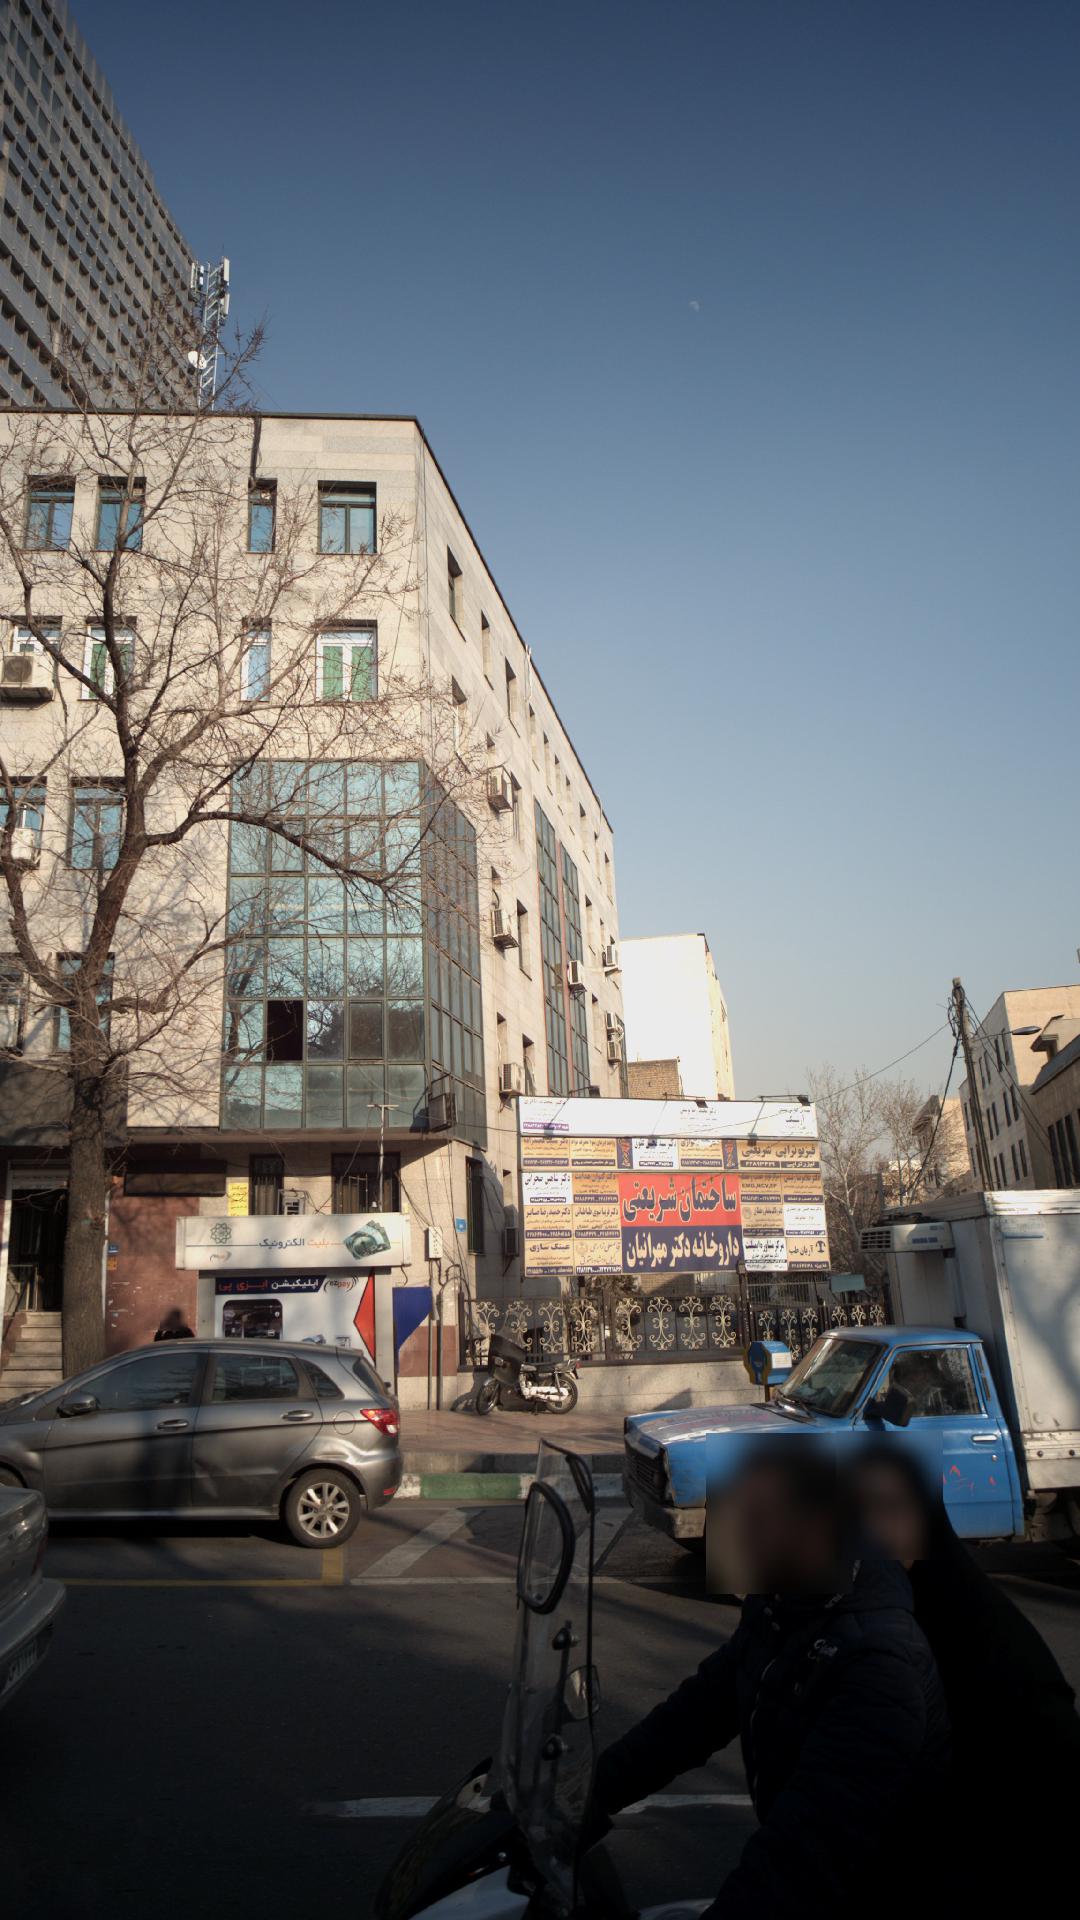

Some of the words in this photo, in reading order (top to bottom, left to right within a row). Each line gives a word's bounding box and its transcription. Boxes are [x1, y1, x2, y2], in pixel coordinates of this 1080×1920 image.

[623, 1177, 677, 1222] شریعتی
[678, 1175, 737, 1222] ساختمان
[561, 1207, 570, 1217] دکتر
[258, 1238, 305, 1250] الکترونیک
[626, 1231, 667, 1268] مهرانیان
[669, 1231, 690, 1267] دکتر
[692, 1231, 739, 1265] داروخانه
[788, 1245, 799, 1255] طب
[799, 1244, 814, 1257] آریان
[271, 1278, 319, 1290] اپلیکیشن
